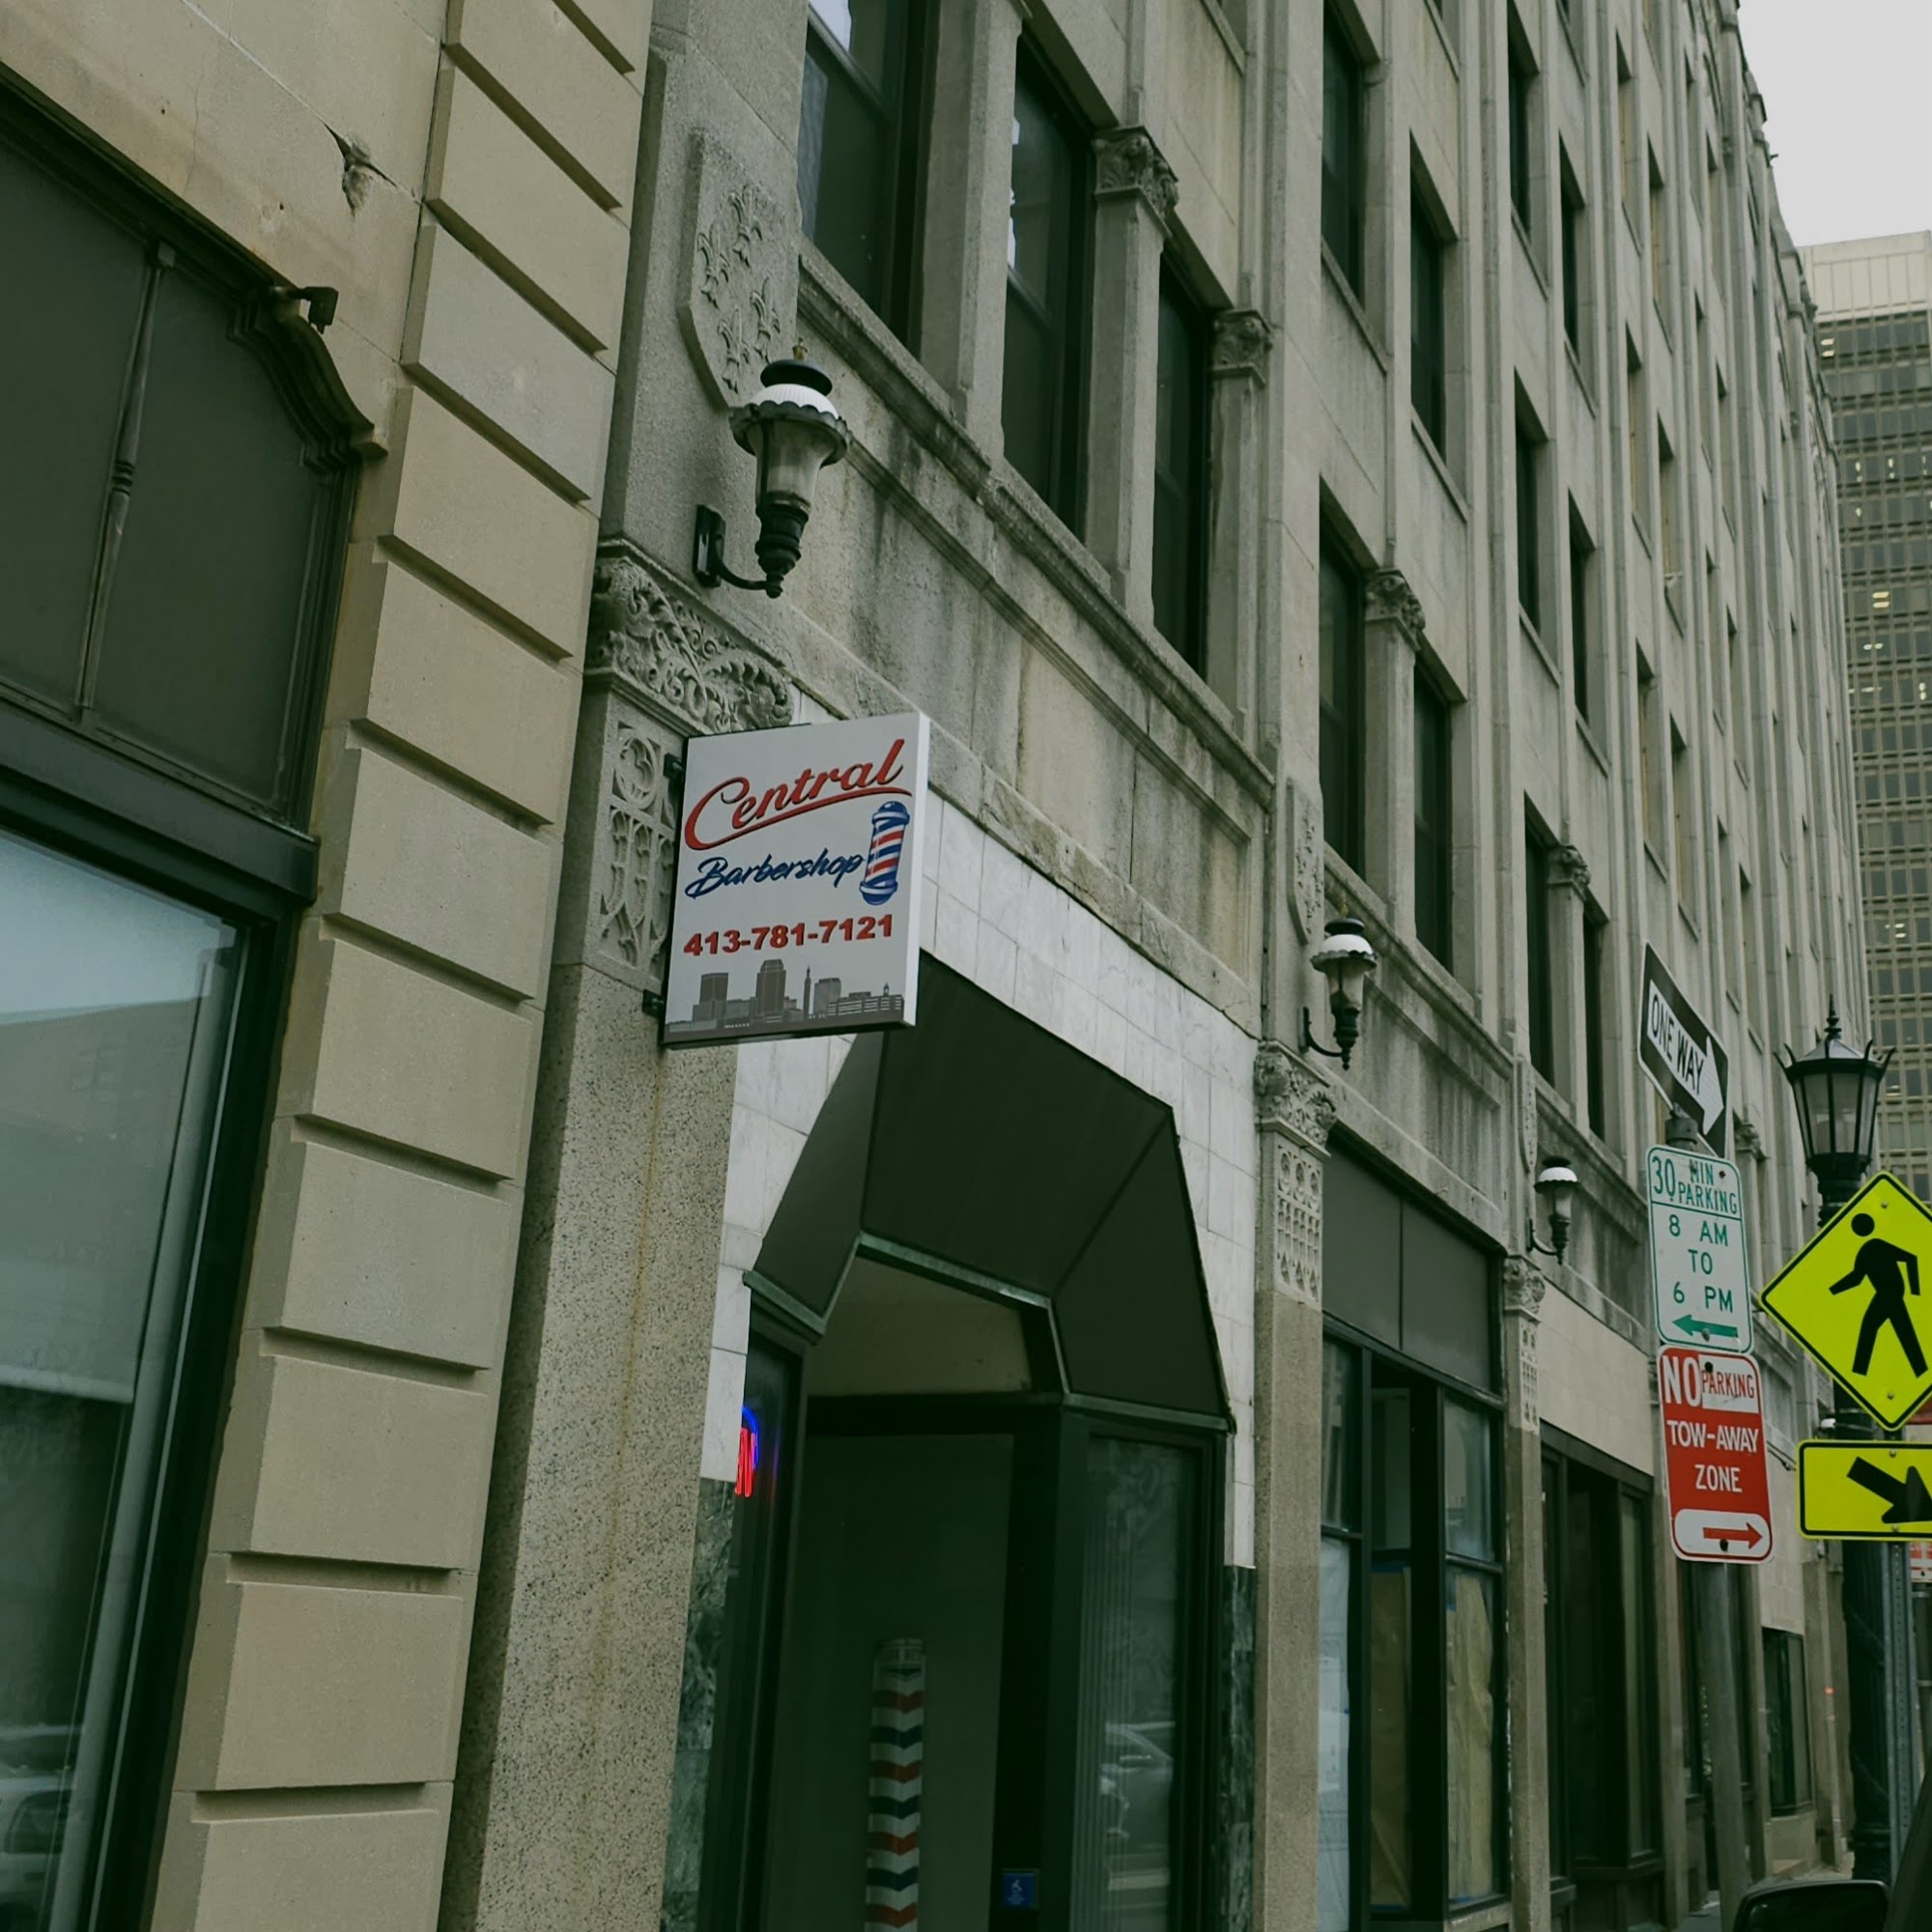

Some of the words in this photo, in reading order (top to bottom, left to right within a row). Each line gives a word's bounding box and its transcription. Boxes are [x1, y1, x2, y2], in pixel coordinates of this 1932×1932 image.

[685, 739, 906, 850] Central
[685, 848, 863, 898] Barbershop
[684, 914, 893, 956] 413-781-7121
[1652, 994, 1674, 1062] ONE
[1677, 1030, 1704, 1094] WAY
[1652, 1155, 1676, 1197] 30
[1690, 1158, 1715, 1185] MIN
[1679, 1181, 1737, 1214] PARKING
[1669, 1214, 1681, 1236] 8
[1699, 1220, 1728, 1246] AM
[1688, 1249, 1713, 1274] TO
[1673, 1281, 1685, 1304] 6
[1704, 1286, 1733, 1313] PM
[1662, 1355, 1702, 1406] NO
[1702, 1370, 1755, 1399] PARKING
[1667, 1420, 1759, 1453] TOW-AWAY
[1694, 1464, 1743, 1492] ZONE
